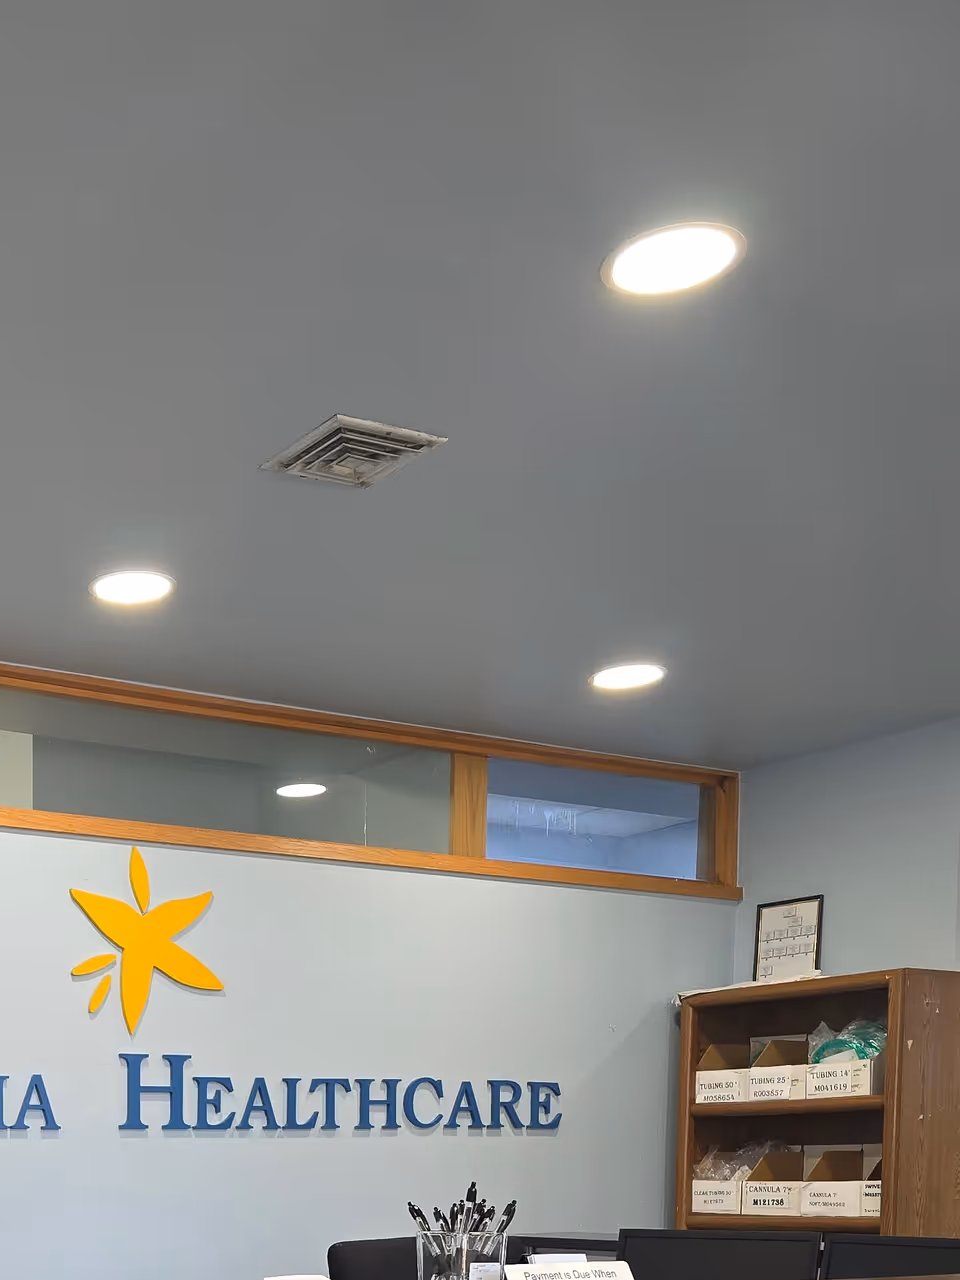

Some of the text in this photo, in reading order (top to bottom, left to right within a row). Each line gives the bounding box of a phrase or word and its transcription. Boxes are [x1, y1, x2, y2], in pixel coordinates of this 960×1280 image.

[811, 1070, 837, 1079] TUBING
[750, 1077, 775, 1085] TUBING
[699, 1082, 723, 1090] TUBING
[118, 1053, 562, 1132] HEALTHCARE
[748, 1185, 781, 1193] CANNULA
[572, 1269, 591, 1279] Due
[591, 1269, 617, 1278] When
